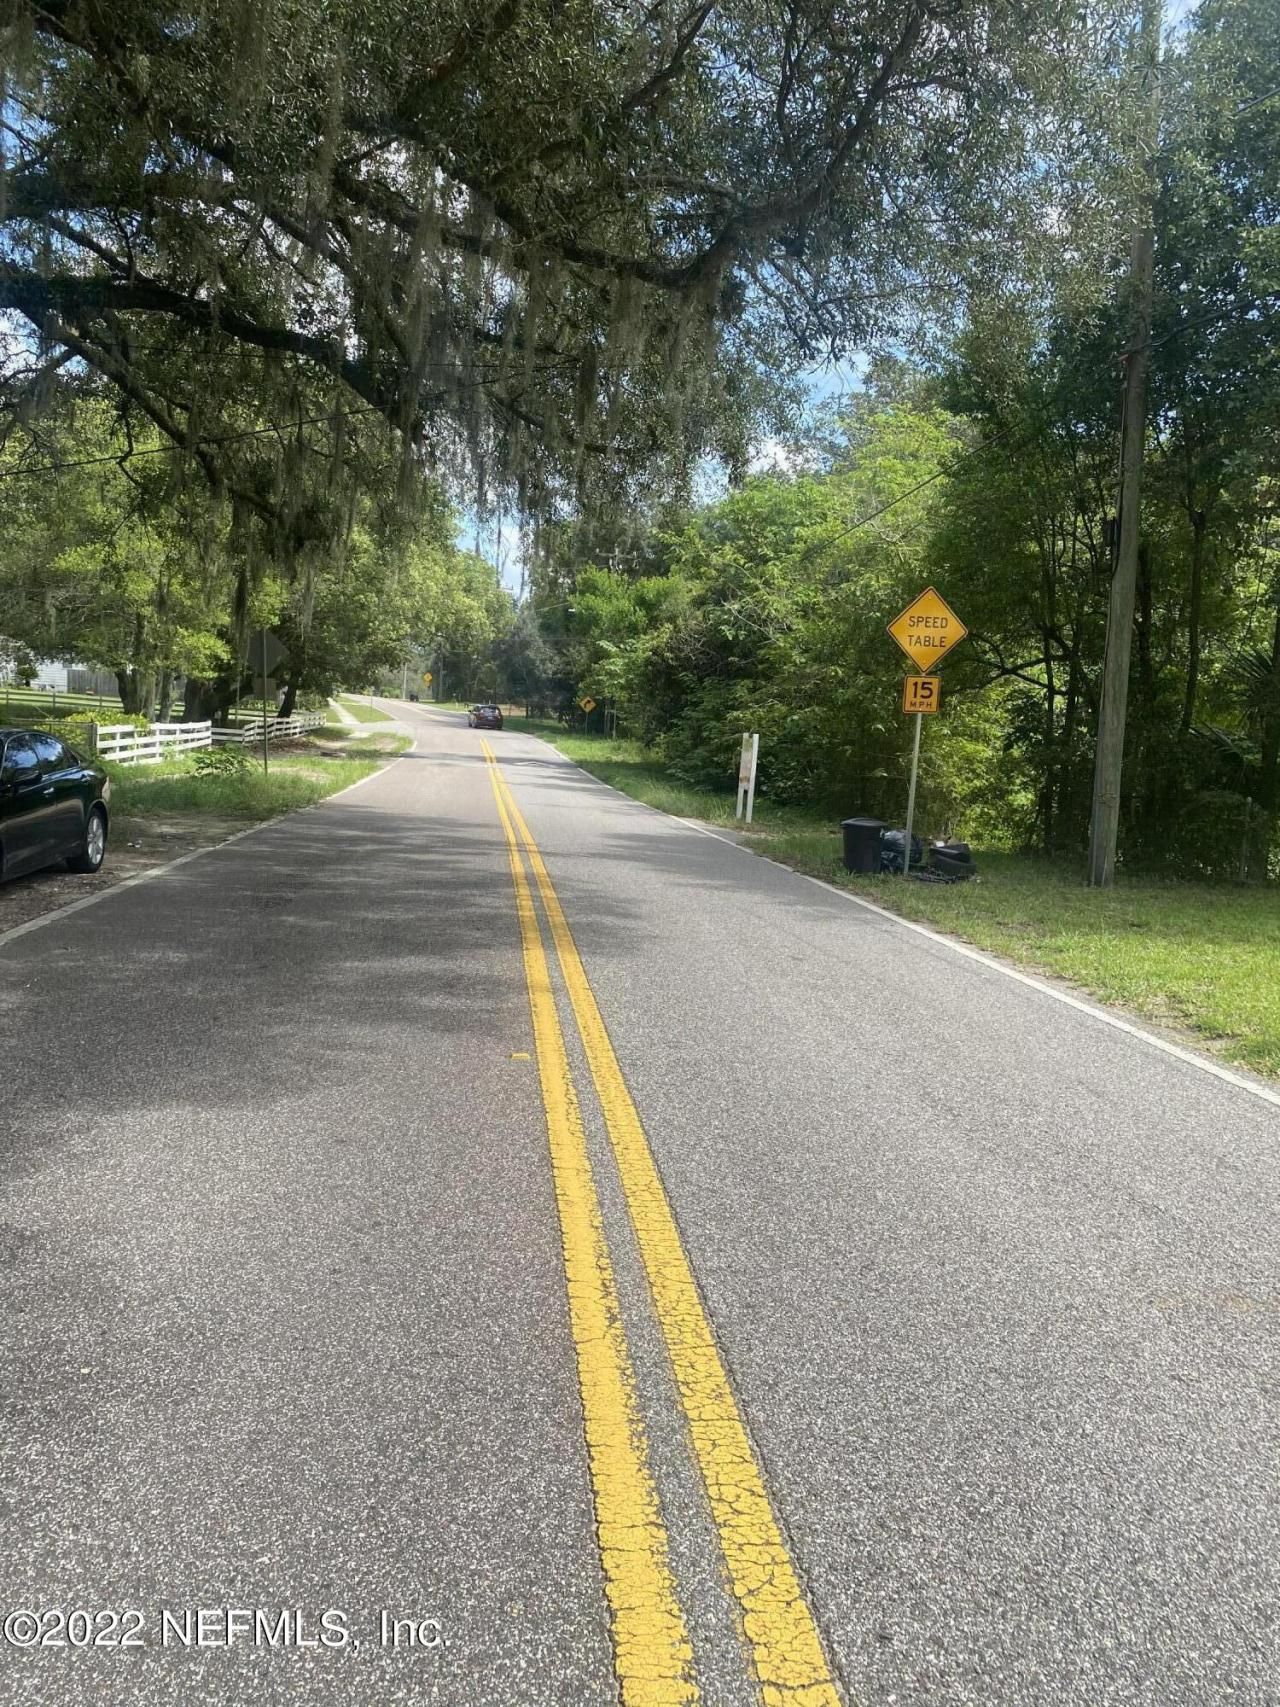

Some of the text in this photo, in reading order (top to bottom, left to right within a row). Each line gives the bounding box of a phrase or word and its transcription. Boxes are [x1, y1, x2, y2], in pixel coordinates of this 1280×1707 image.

[908, 616, 948, 629] SPEED
[908, 635, 946, 647] TABLE
[913, 681, 933, 699] 15
